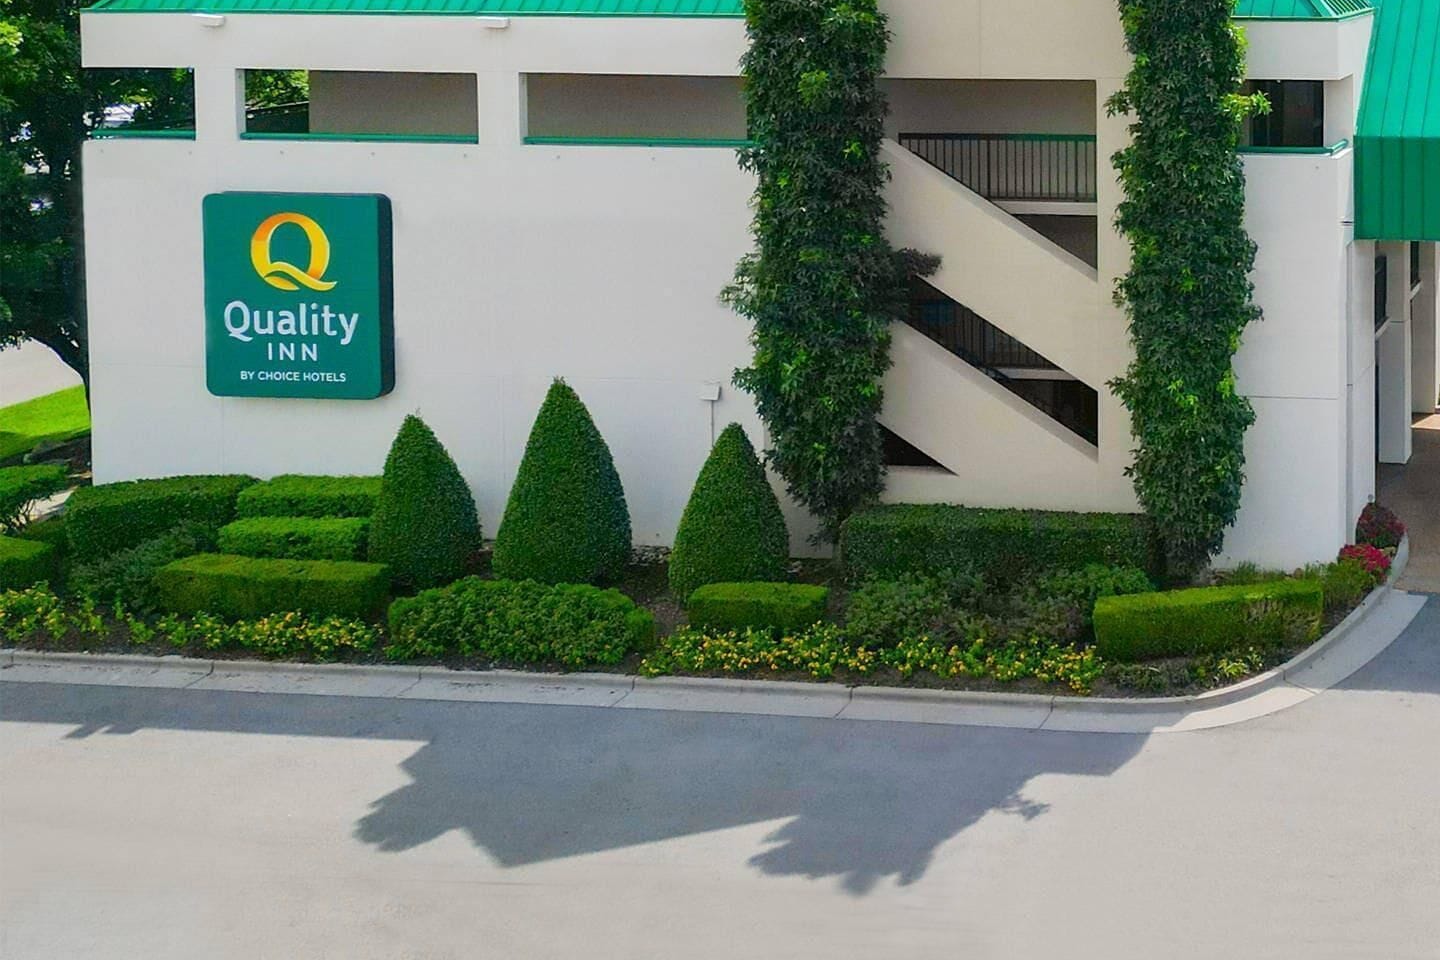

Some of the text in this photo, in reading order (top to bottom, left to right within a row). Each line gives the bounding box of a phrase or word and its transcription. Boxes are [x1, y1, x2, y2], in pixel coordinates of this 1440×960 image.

[250, 211, 338, 291] Q
[224, 300, 359, 345] Quality
[268, 342, 318, 362] INN
[240, 370, 346, 382] BY CHOICE HOTELS
